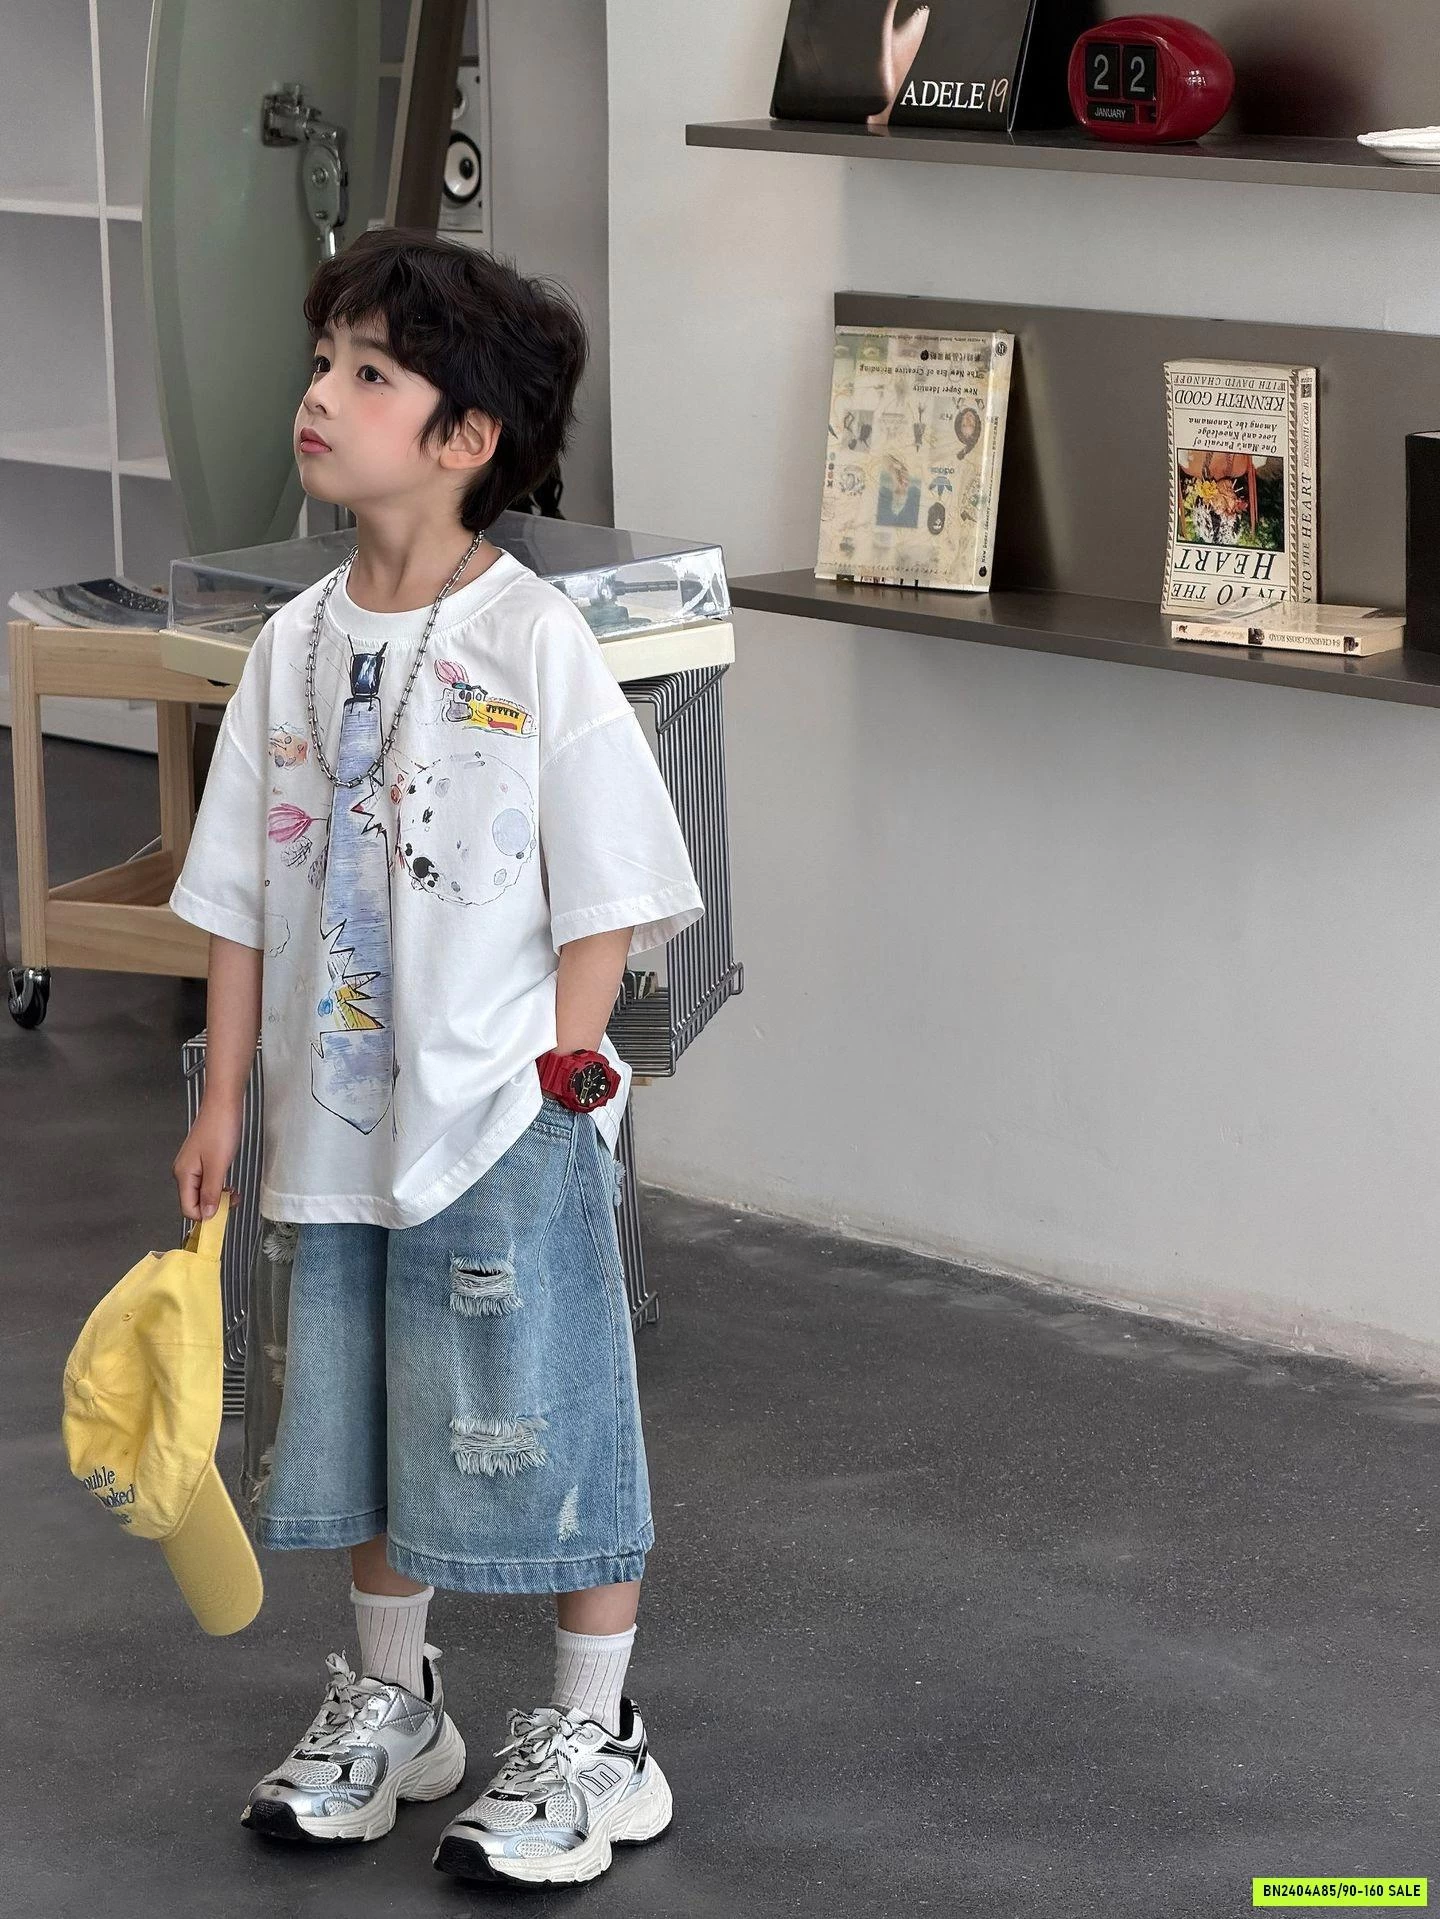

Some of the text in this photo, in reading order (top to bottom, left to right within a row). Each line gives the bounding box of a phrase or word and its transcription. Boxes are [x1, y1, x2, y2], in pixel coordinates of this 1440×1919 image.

[900, 77, 1009, 113] ADELE 19
[1094, 107, 1126, 119] JANUARY
[895, 366, 926, 376] Creative
[926, 367, 935, 376] of
[936, 368, 949, 377] Era
[950, 369, 965, 378] New
[966, 370, 980, 379] The
[912, 384, 978, 395] New Super Identity
[1173, 375, 1286, 391] WITH DAVID CHANOFF
[1174, 389, 1285, 412] KENNETH GOOD
[1188, 417, 1278, 432] Among the Yanomama
[1197, 427, 1277, 443] Love and Knowledge
[1192, 437, 1277, 454] One Man's Pursuit of
[1302, 472, 1312, 540] HEART
[1174, 548, 1277, 580] HEART
[1171, 584, 1207, 599] THE
[1302, 571, 1312, 604] NTO
[1268, 634, 1285, 643] ROAD
[1305, 637, 1331, 646] CHARING
[83, 1466, 116, 1490] ouble
